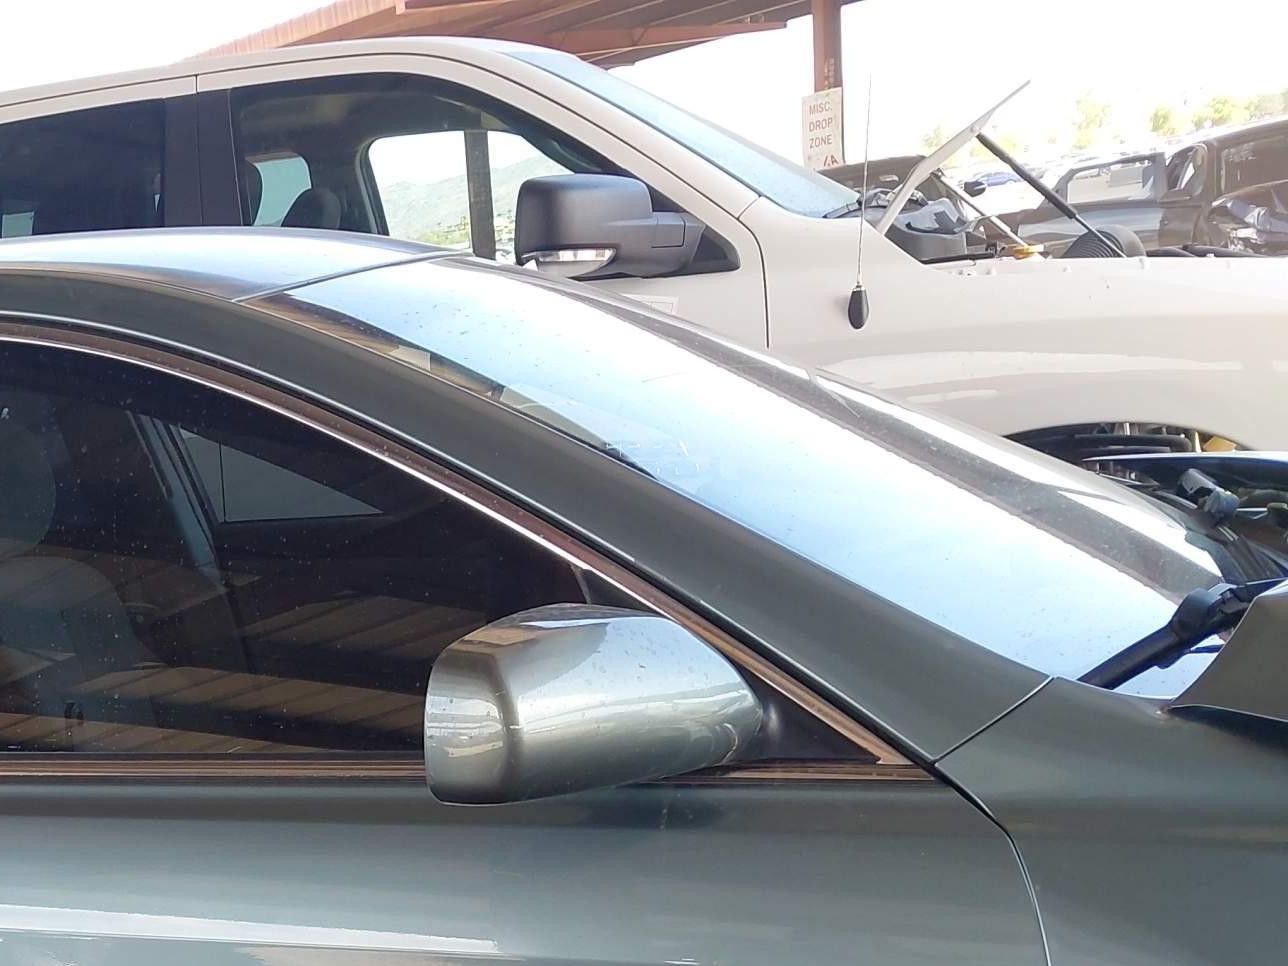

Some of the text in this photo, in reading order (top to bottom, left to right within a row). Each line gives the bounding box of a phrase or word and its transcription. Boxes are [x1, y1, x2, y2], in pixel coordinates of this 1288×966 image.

[809, 101, 833, 115] MISC.
[808, 117, 833, 132] DROP
[809, 134, 833, 149] ZONE
